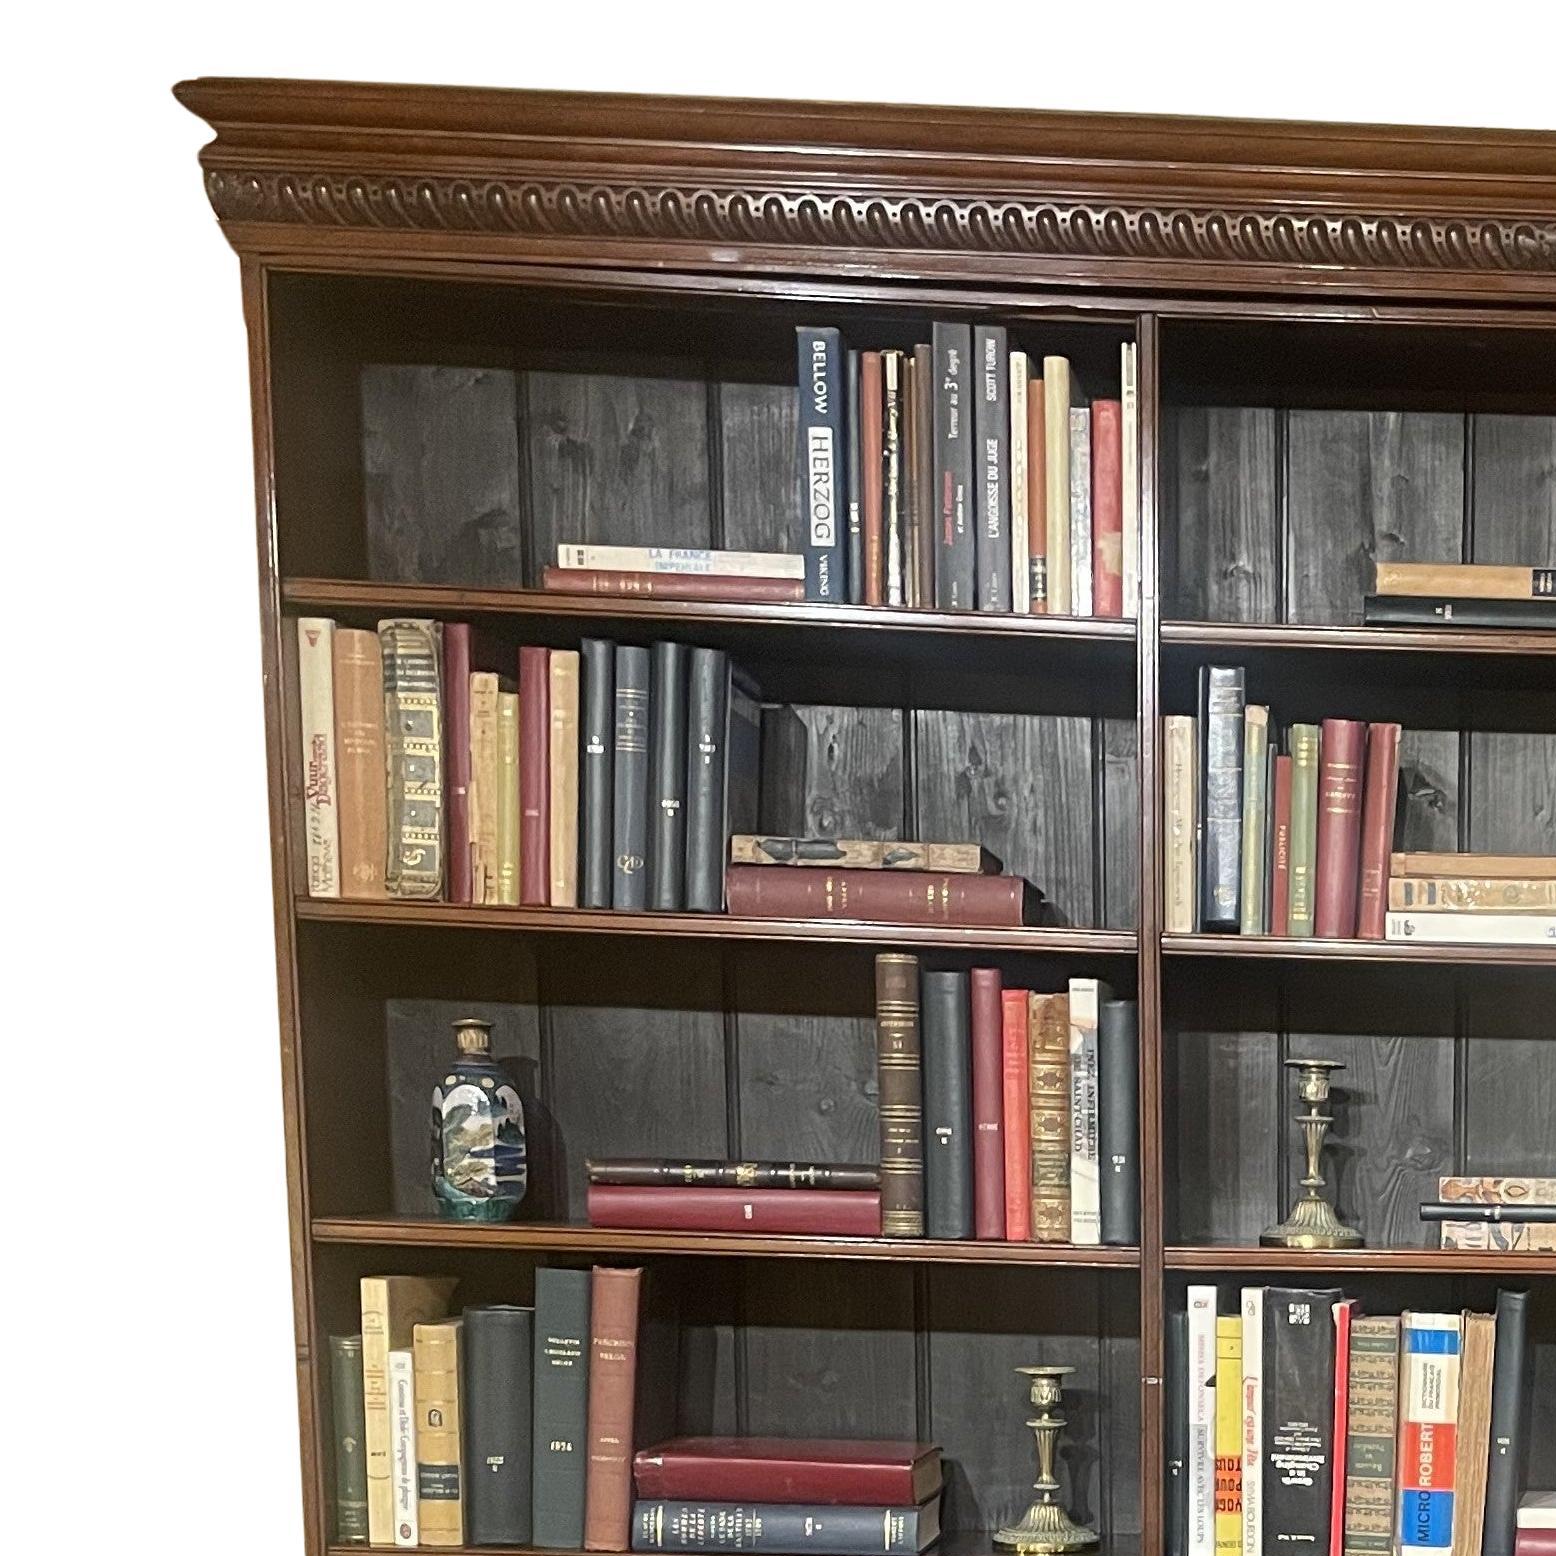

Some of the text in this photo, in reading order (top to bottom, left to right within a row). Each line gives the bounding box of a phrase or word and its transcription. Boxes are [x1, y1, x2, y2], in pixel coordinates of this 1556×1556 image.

[811, 340, 829, 415] BELLOW
[810, 435, 832, 541] HERZOG
[818, 553, 831, 597] VIKING
[1418, 1423, 1433, 1487] ROBERT
[1416, 1491, 1430, 1539] MICRO
